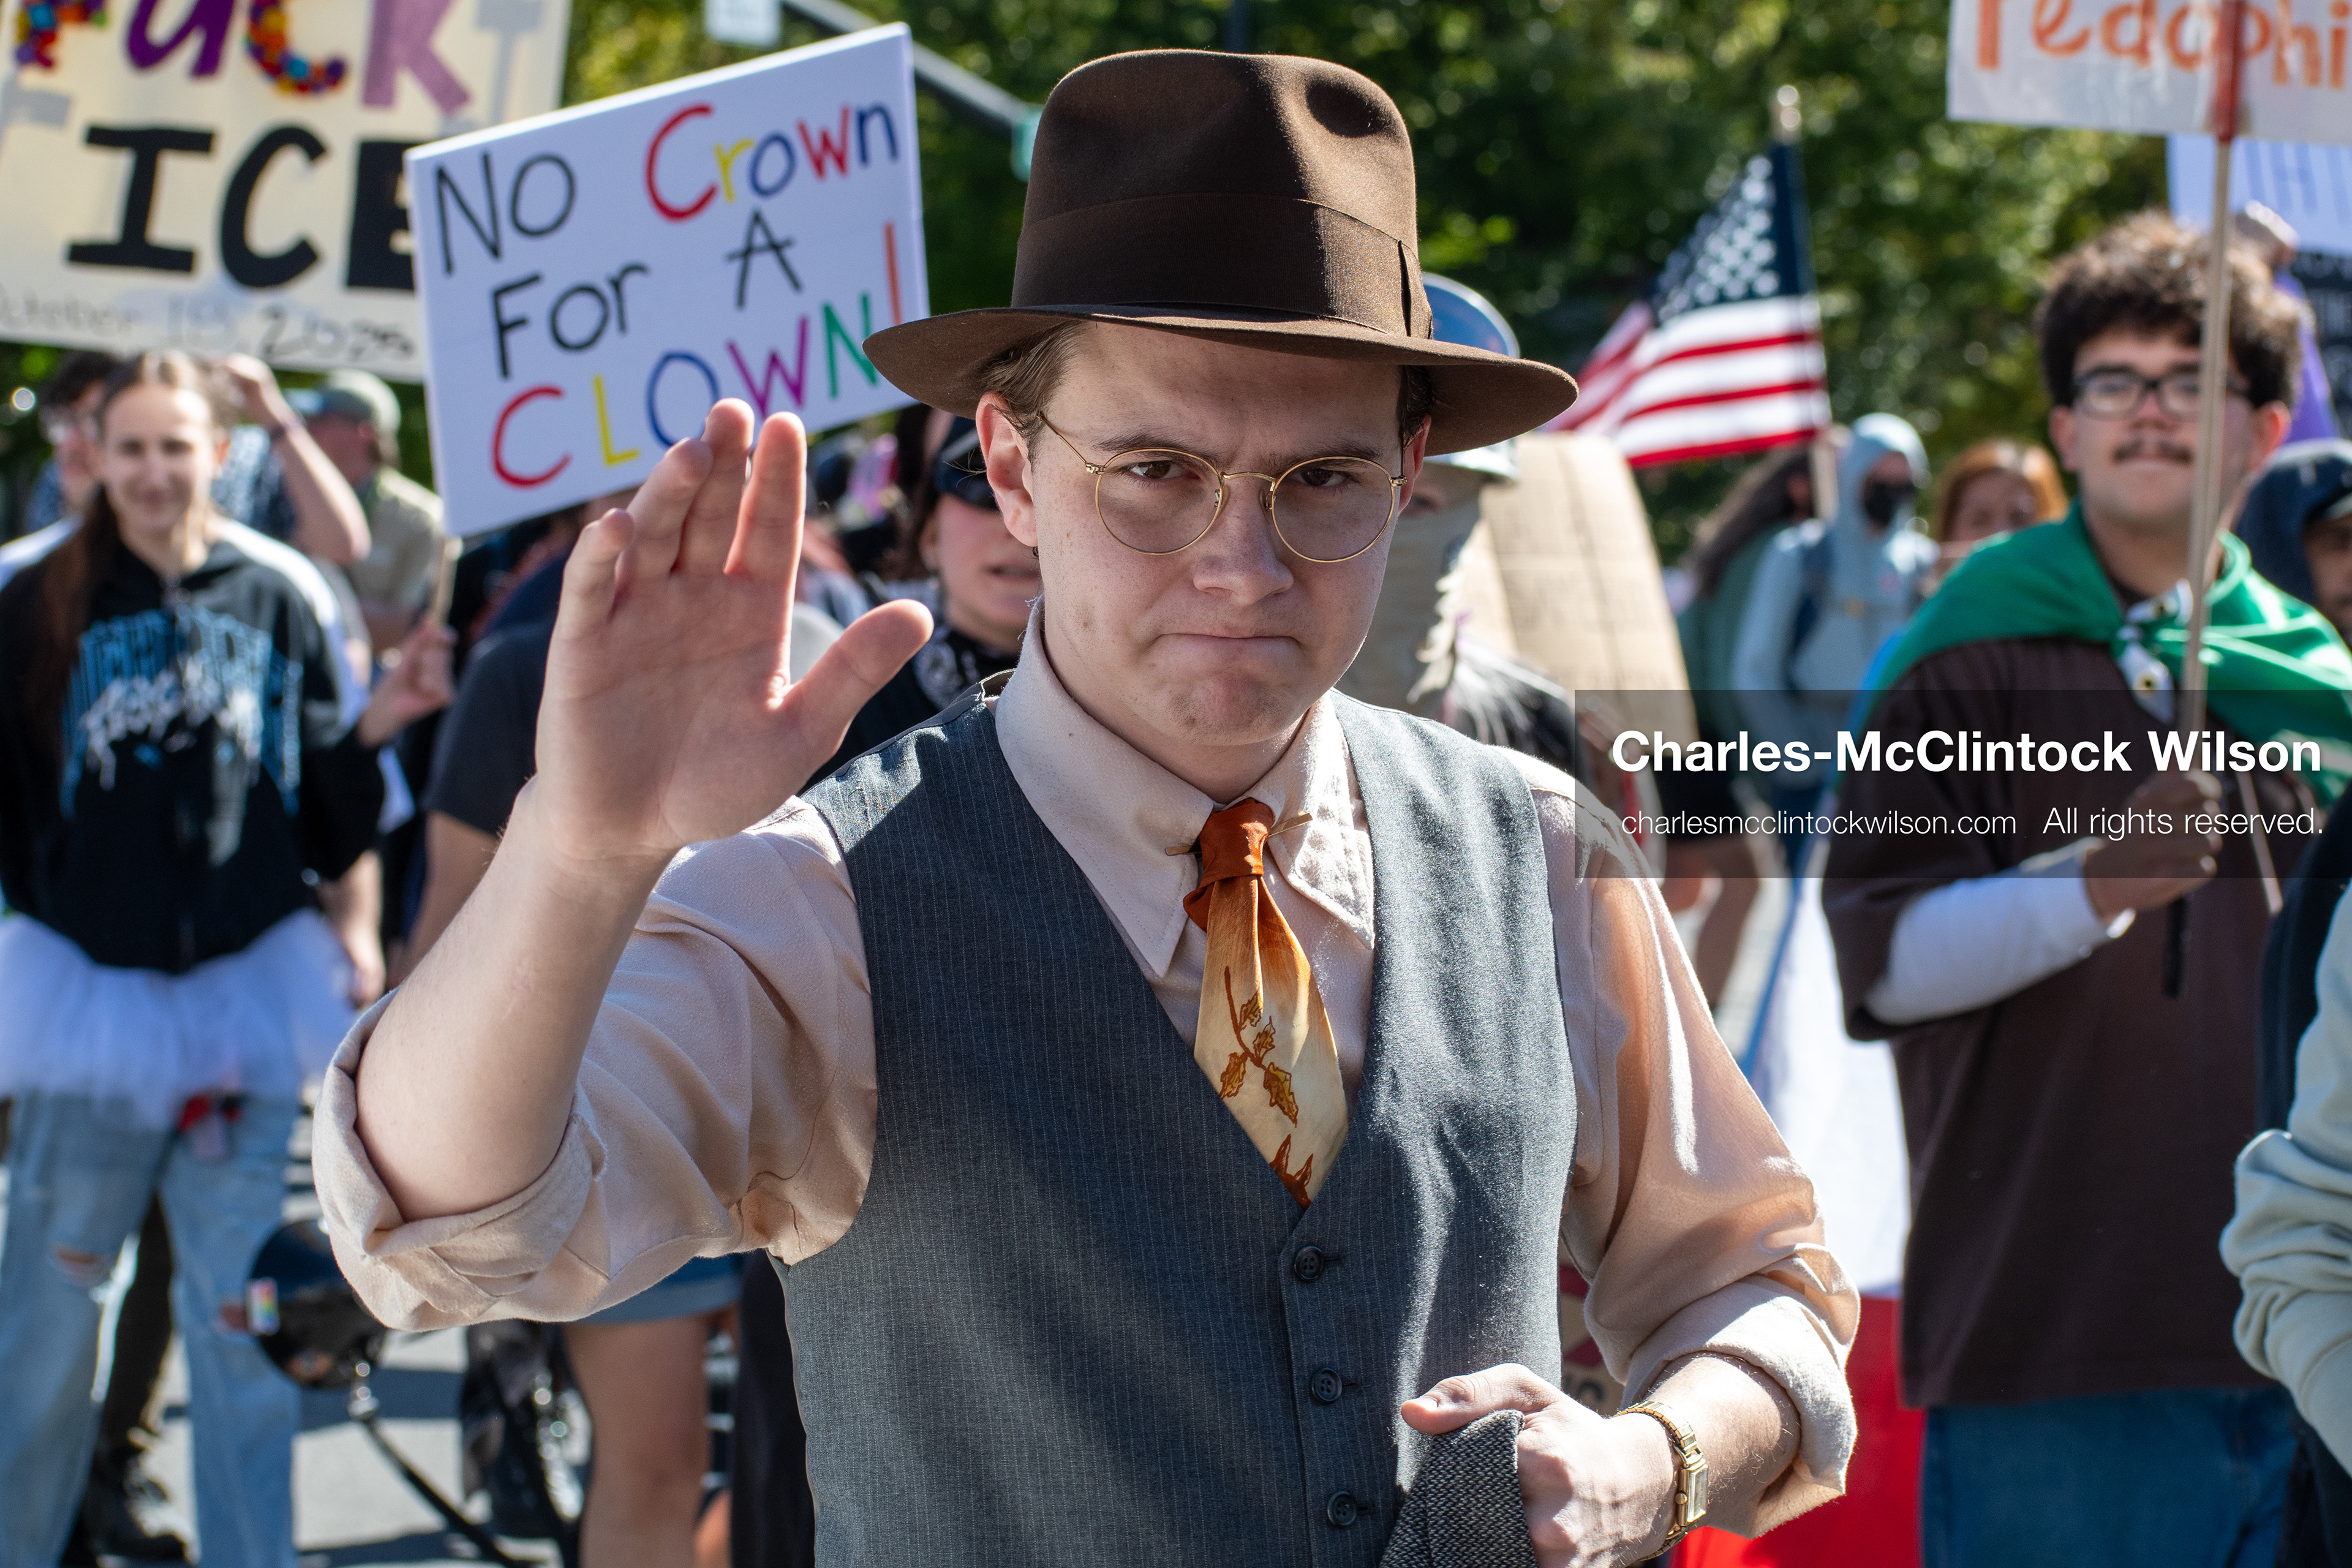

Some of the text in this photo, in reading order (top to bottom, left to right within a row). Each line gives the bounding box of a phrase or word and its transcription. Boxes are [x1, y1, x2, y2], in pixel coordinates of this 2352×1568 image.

[65, 125, 415, 292] ICE
[645, 103, 899, 222] Crown
[491, 208, 802, 379] For A
